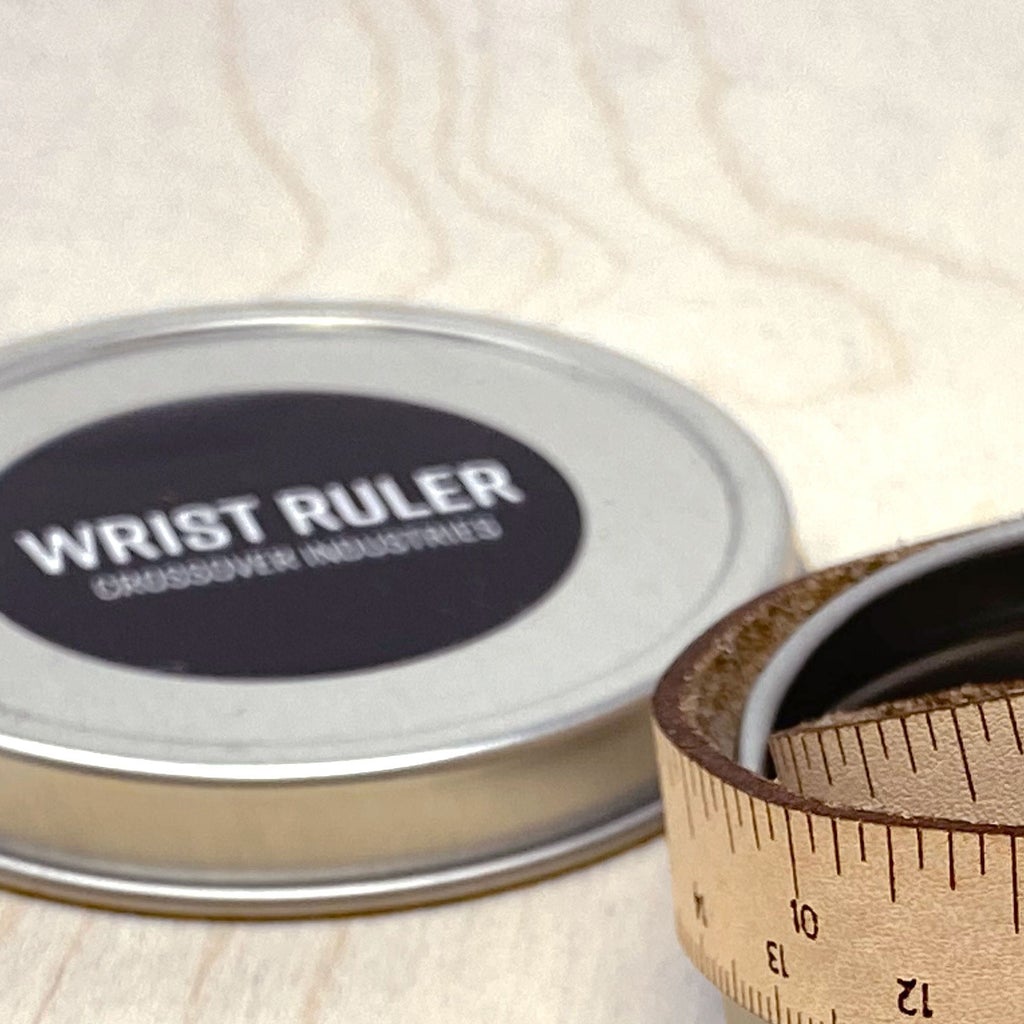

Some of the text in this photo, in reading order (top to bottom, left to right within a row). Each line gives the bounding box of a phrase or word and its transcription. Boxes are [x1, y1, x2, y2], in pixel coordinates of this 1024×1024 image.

[14, 458, 526, 576] WRIST RULER
[90, 513, 504, 601] CROSSOVER INDUSTRIES
[789, 898, 820, 941] 10
[766, 940, 790, 979] 13
[896, 977, 934, 1019] 12
